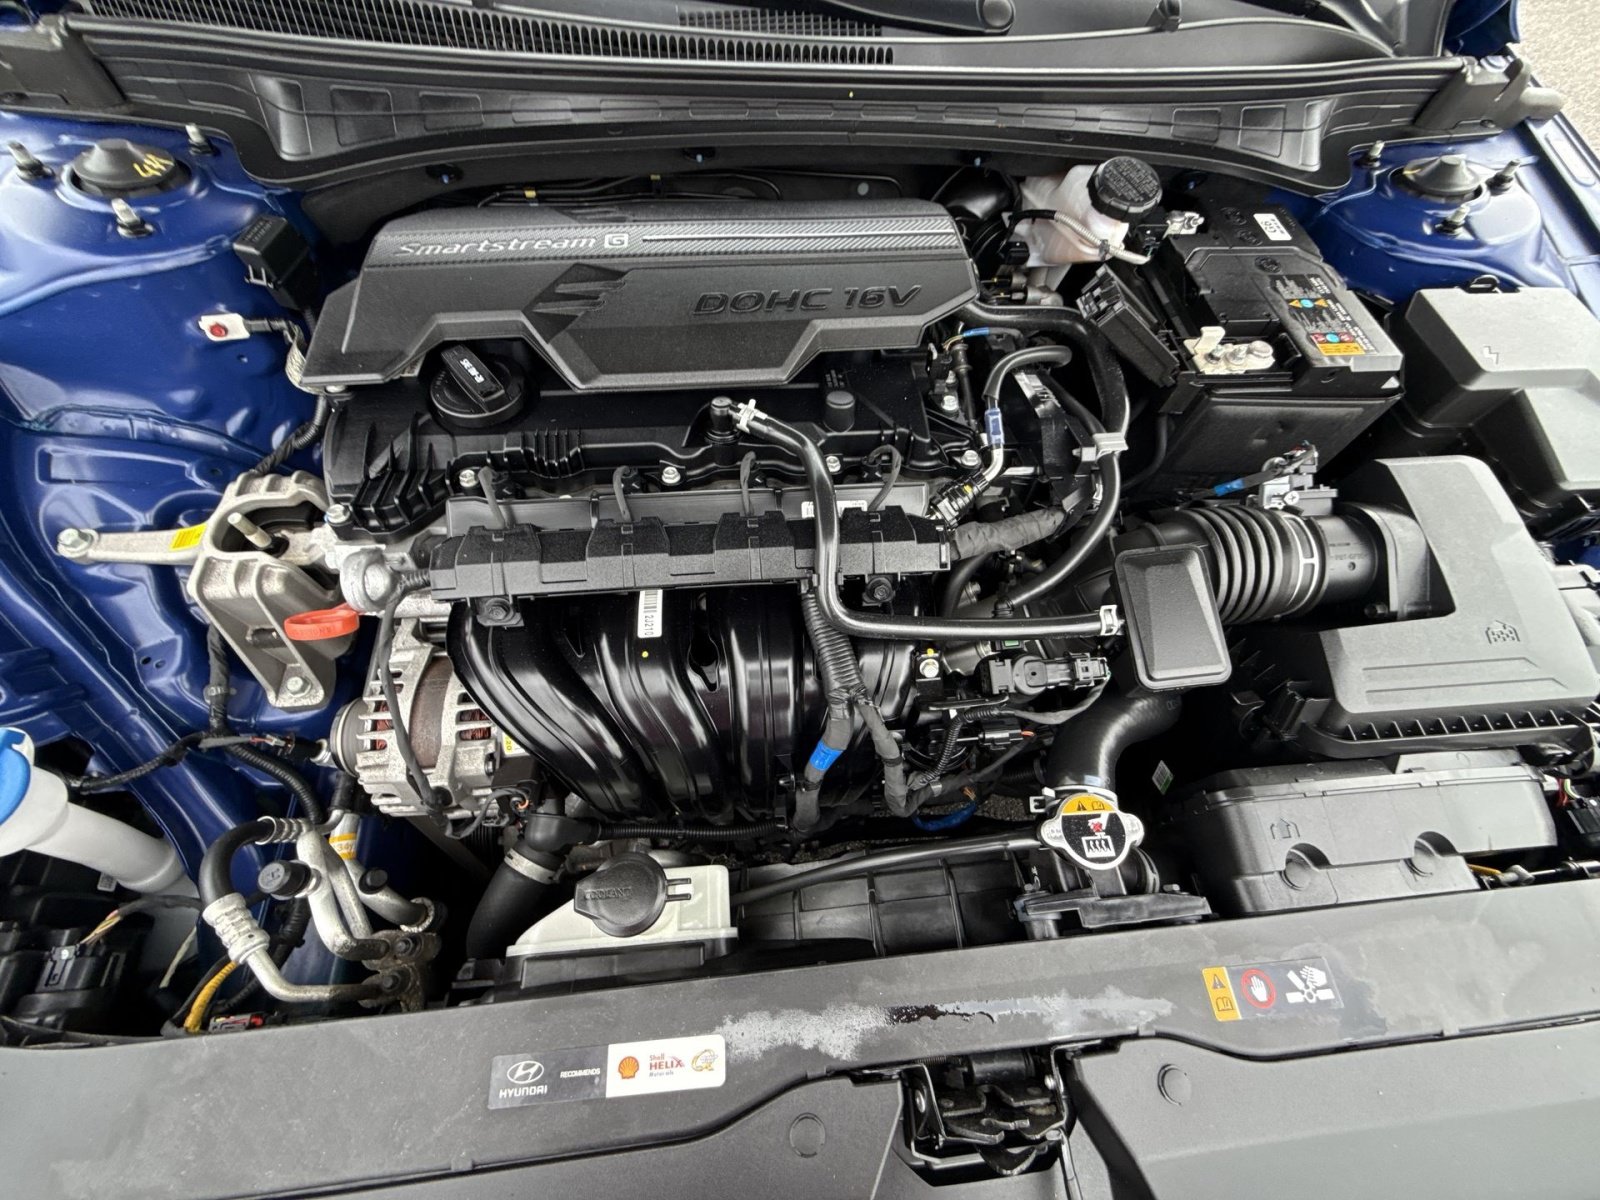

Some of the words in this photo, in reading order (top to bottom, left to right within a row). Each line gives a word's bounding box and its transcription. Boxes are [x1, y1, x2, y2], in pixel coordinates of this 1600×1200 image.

[394, 237, 597, 257] Smartstream
[693, 287, 833, 315] DOHC
[844, 284, 922, 310] 16V
[649, 1053, 665, 1061] Shell
[649, 1059, 685, 1071] HELIX
[559, 1068, 601, 1079] RECOMMENDS
[499, 1085, 548, 1099] HYUNDAI
